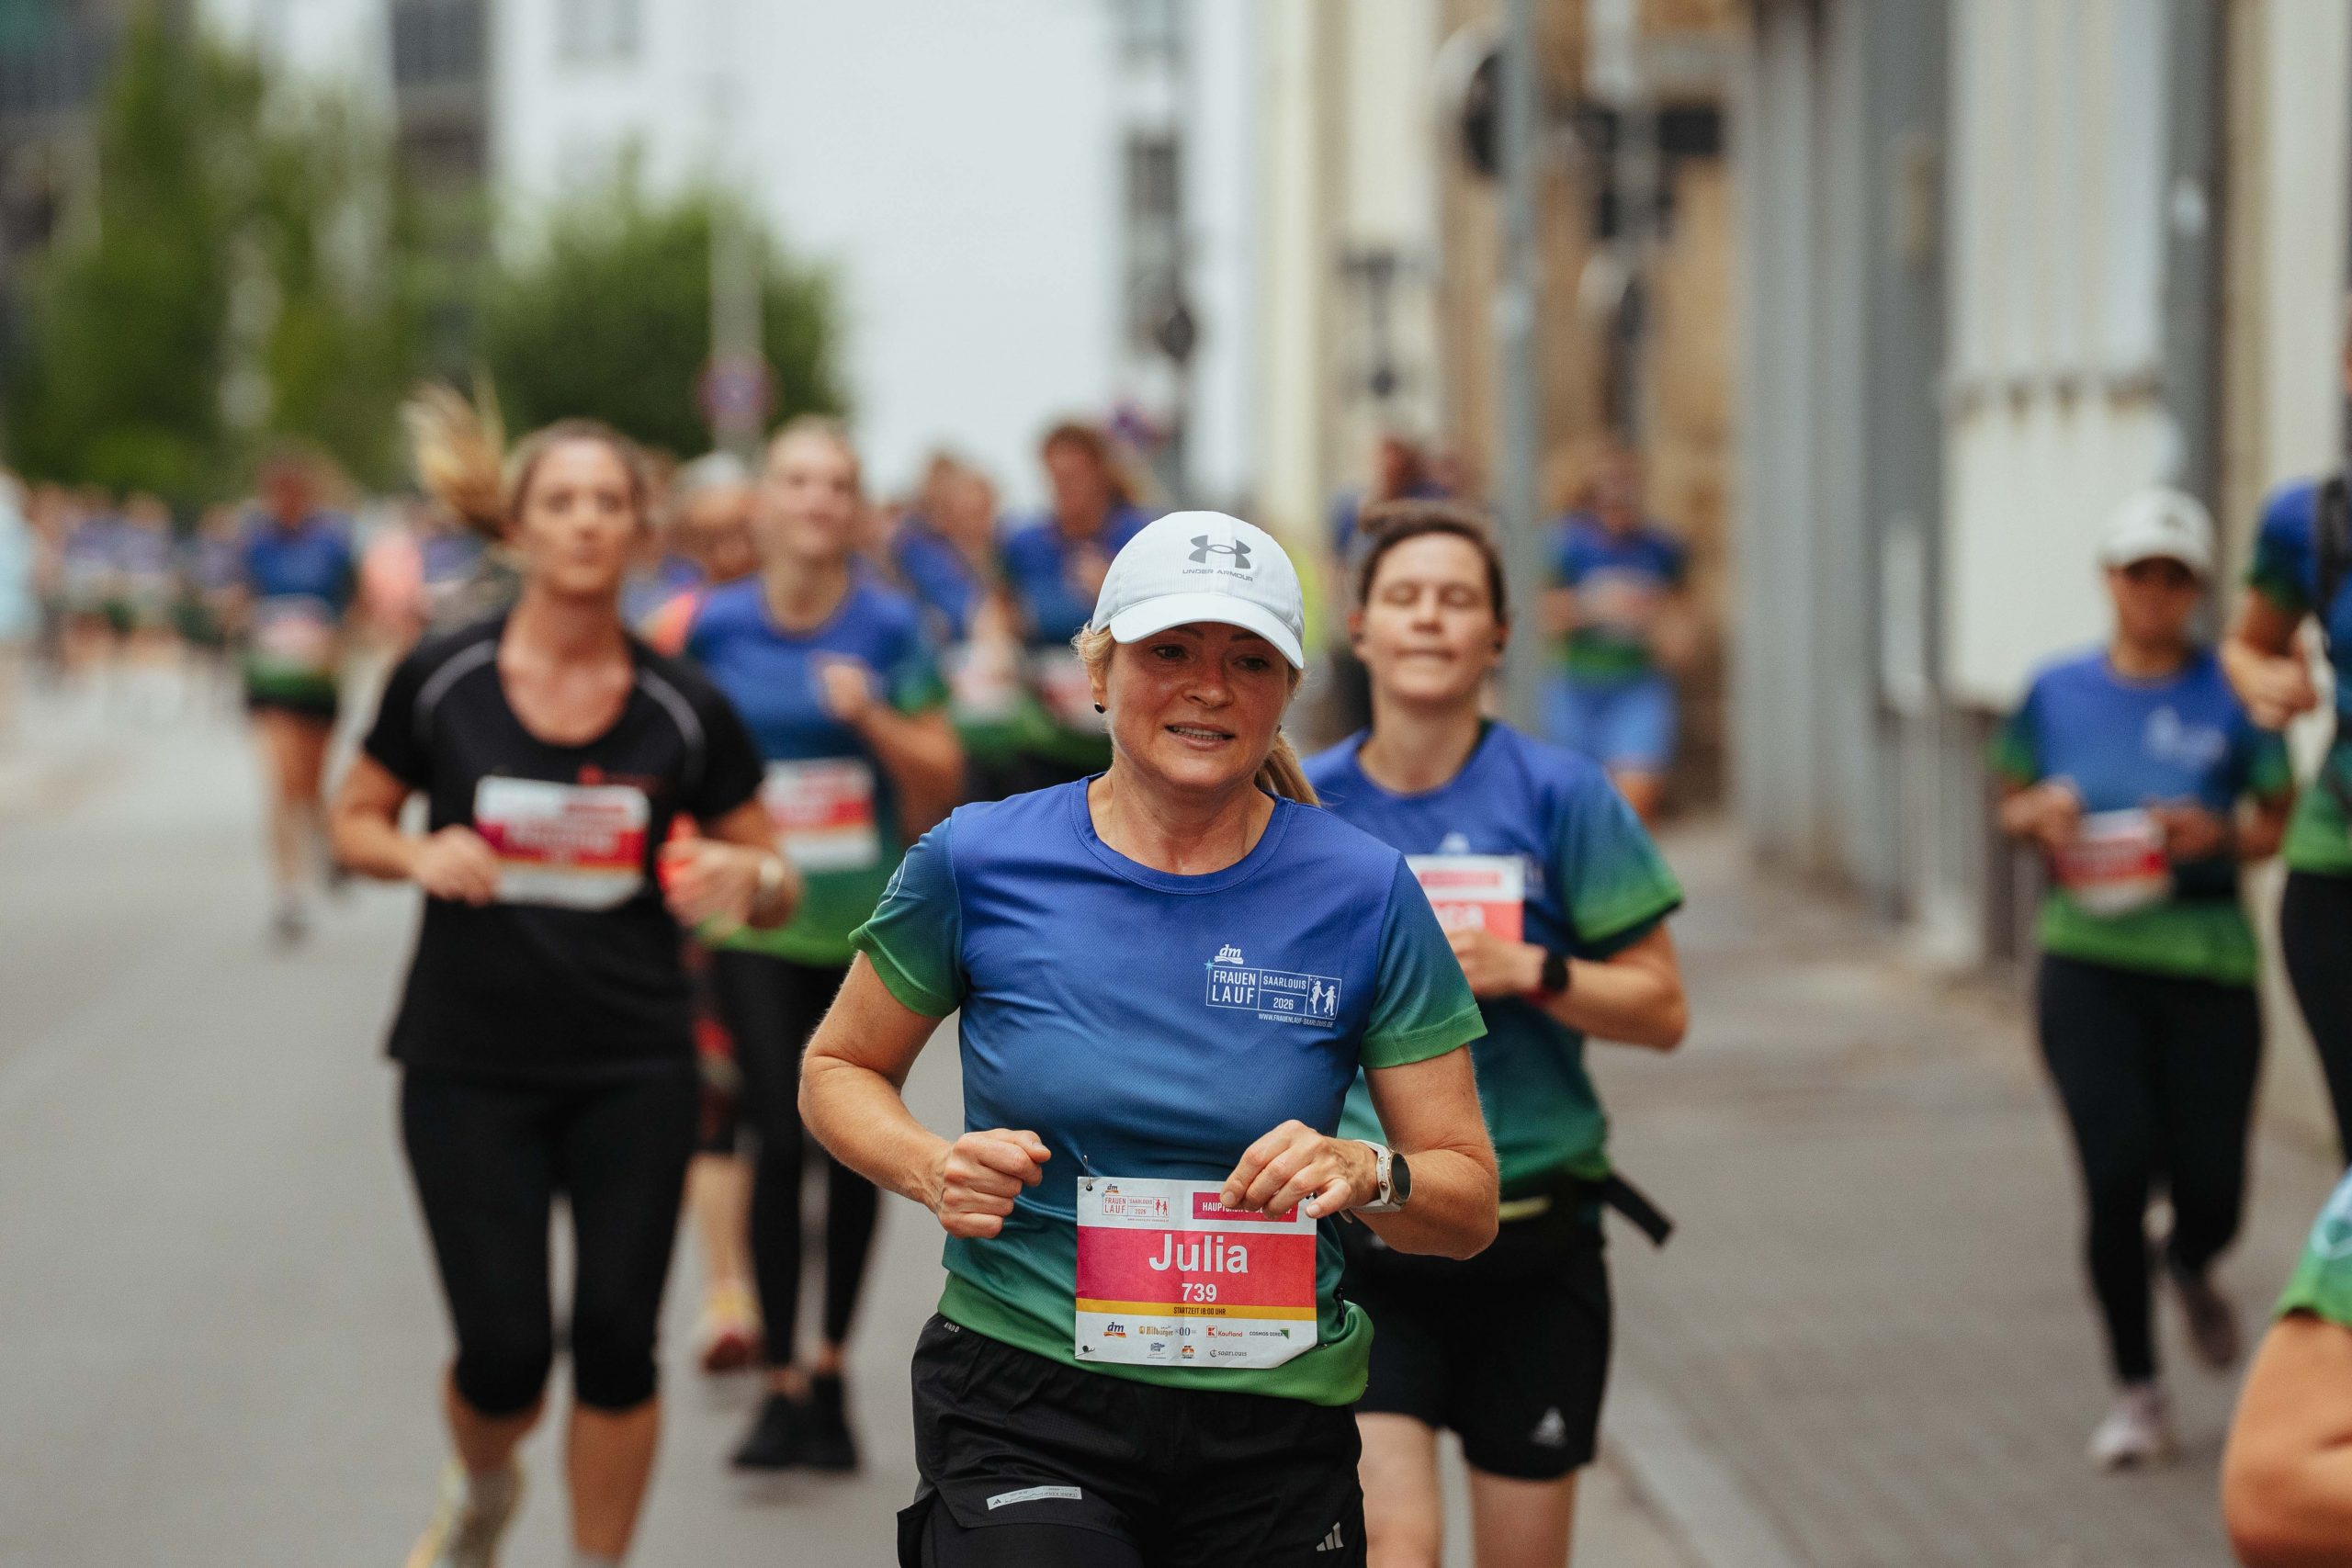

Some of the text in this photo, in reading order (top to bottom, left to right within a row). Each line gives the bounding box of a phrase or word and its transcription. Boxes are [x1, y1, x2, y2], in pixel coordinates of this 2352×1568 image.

[1216, 570, 1253, 581] ARMOUR
[1219, 944, 1242, 957] dm
[1213, 970, 1256, 986] FRAUEN
[1262, 976, 1306, 989] SAARLOUIS
[1212, 985, 1255, 1004] LAUF
[1272, 997, 1294, 1010] 2026
[1104, 1204, 1125, 1213] LAUF
[1148, 1234, 1249, 1274] Julia
[1182, 1282, 1217, 1303] 739
[1173, 1306, 1199, 1314] STARTZEIT
[1107, 1322, 1125, 1333] dm
